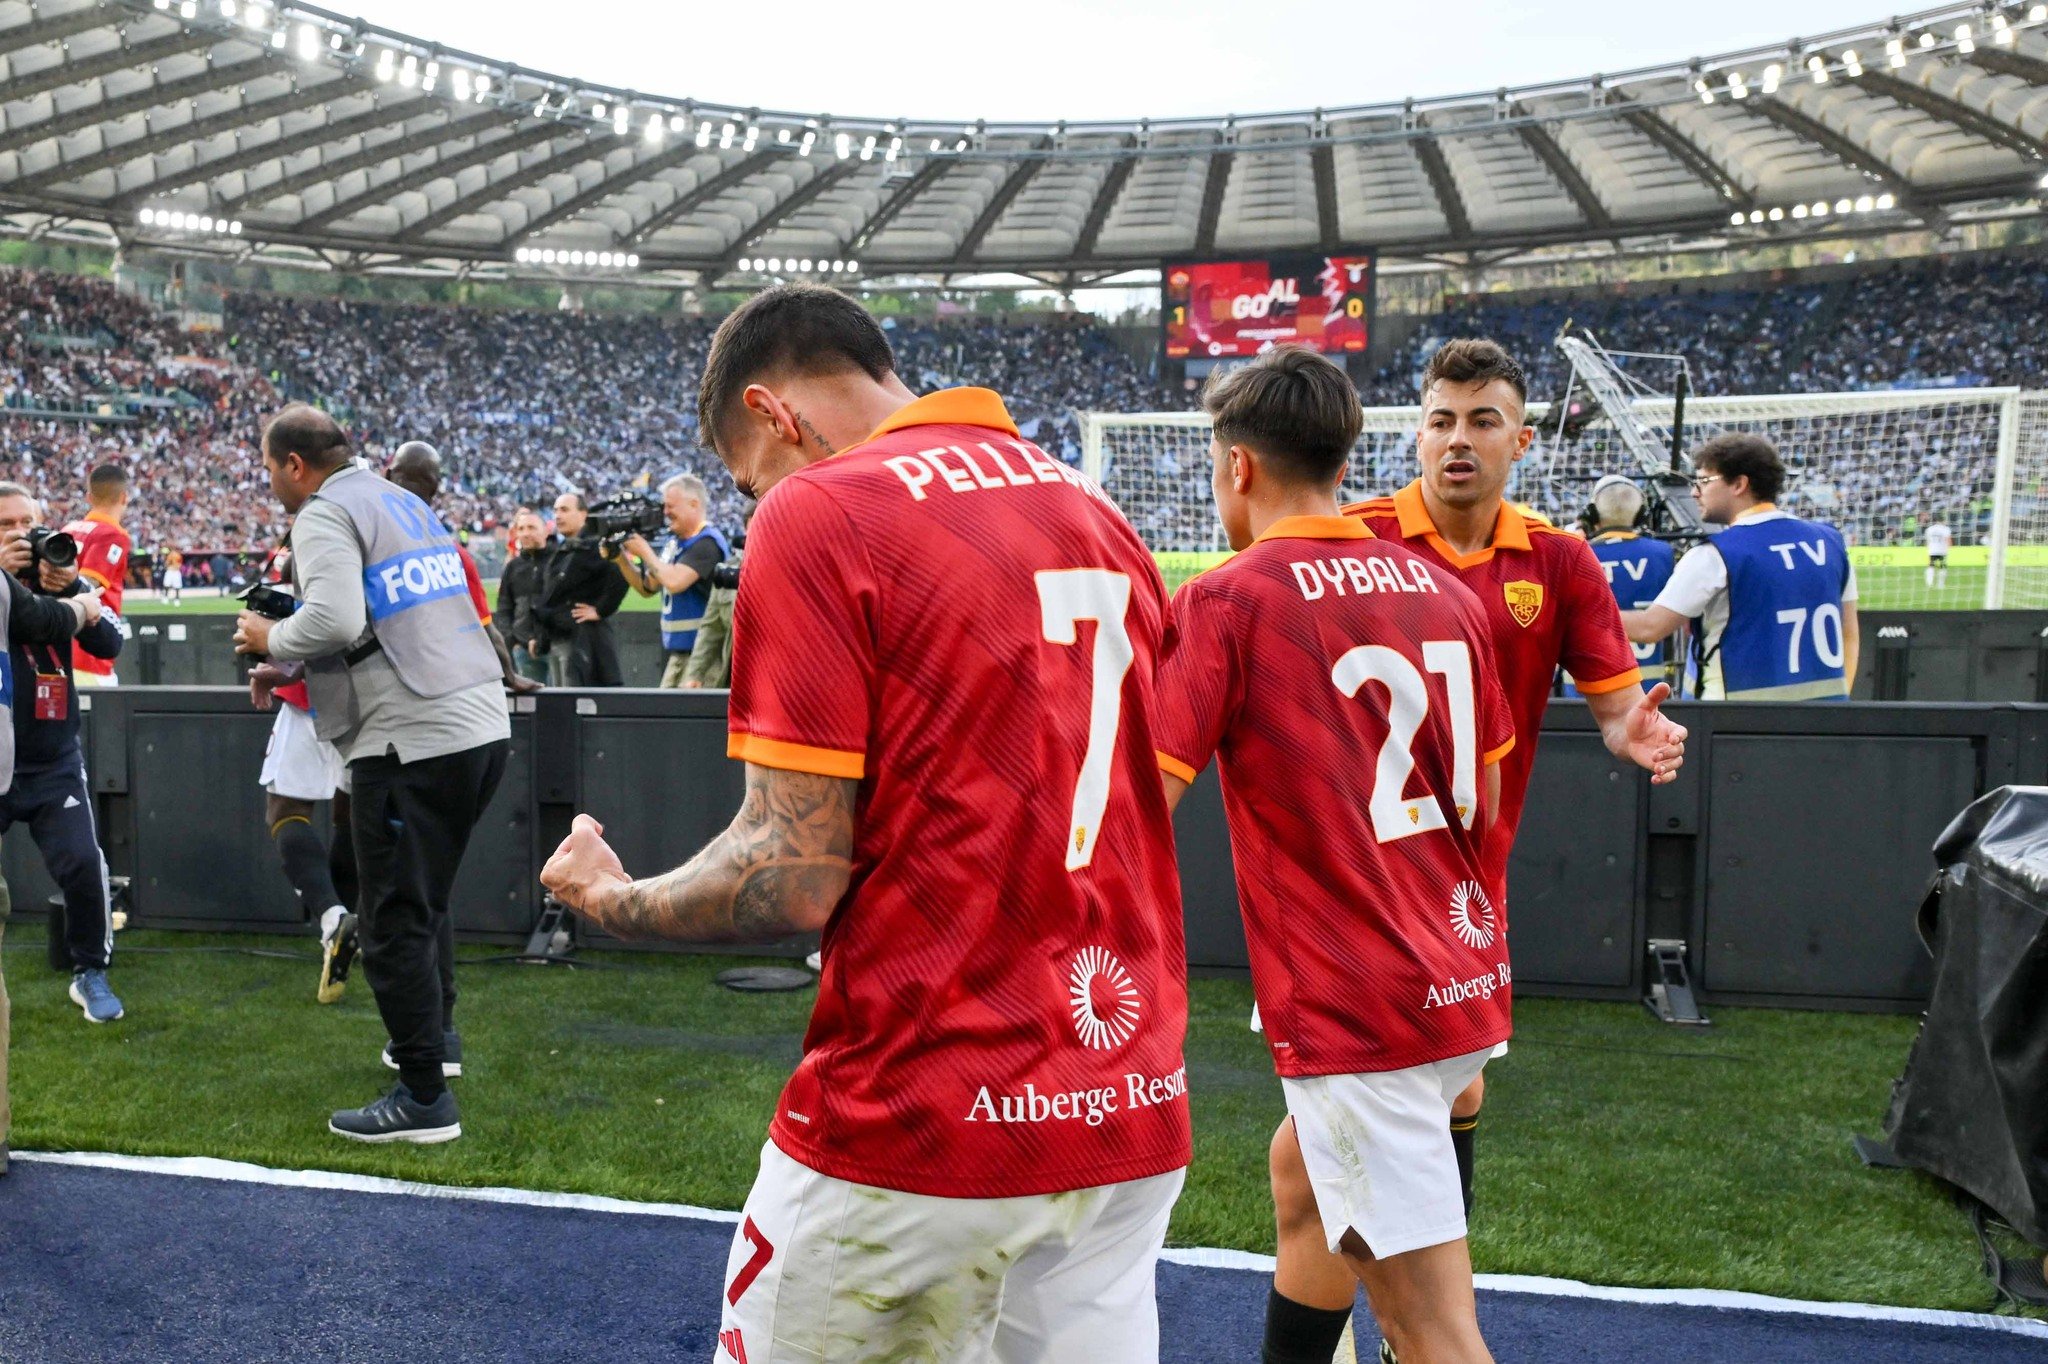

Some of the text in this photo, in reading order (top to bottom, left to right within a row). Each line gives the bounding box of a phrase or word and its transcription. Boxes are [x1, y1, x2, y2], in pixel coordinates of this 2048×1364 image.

[1173, 306, 1185, 326] 1
[1232, 278, 1300, 320] GOAL
[1347, 298, 1364, 318] 0
[1600, 557, 1648, 583] TV
[1769, 539, 1826, 570] TV
[1289, 556, 1440, 601] DYBALA
[1777, 603, 1844, 674] 70
[1034, 567, 1134, 873] 7
[1331, 640, 1478, 844] 21
[1422, 973, 1497, 1009] Auberge
[964, 1060, 1188, 1127] Auberge Resor
[727, 1214, 775, 1308] 7
